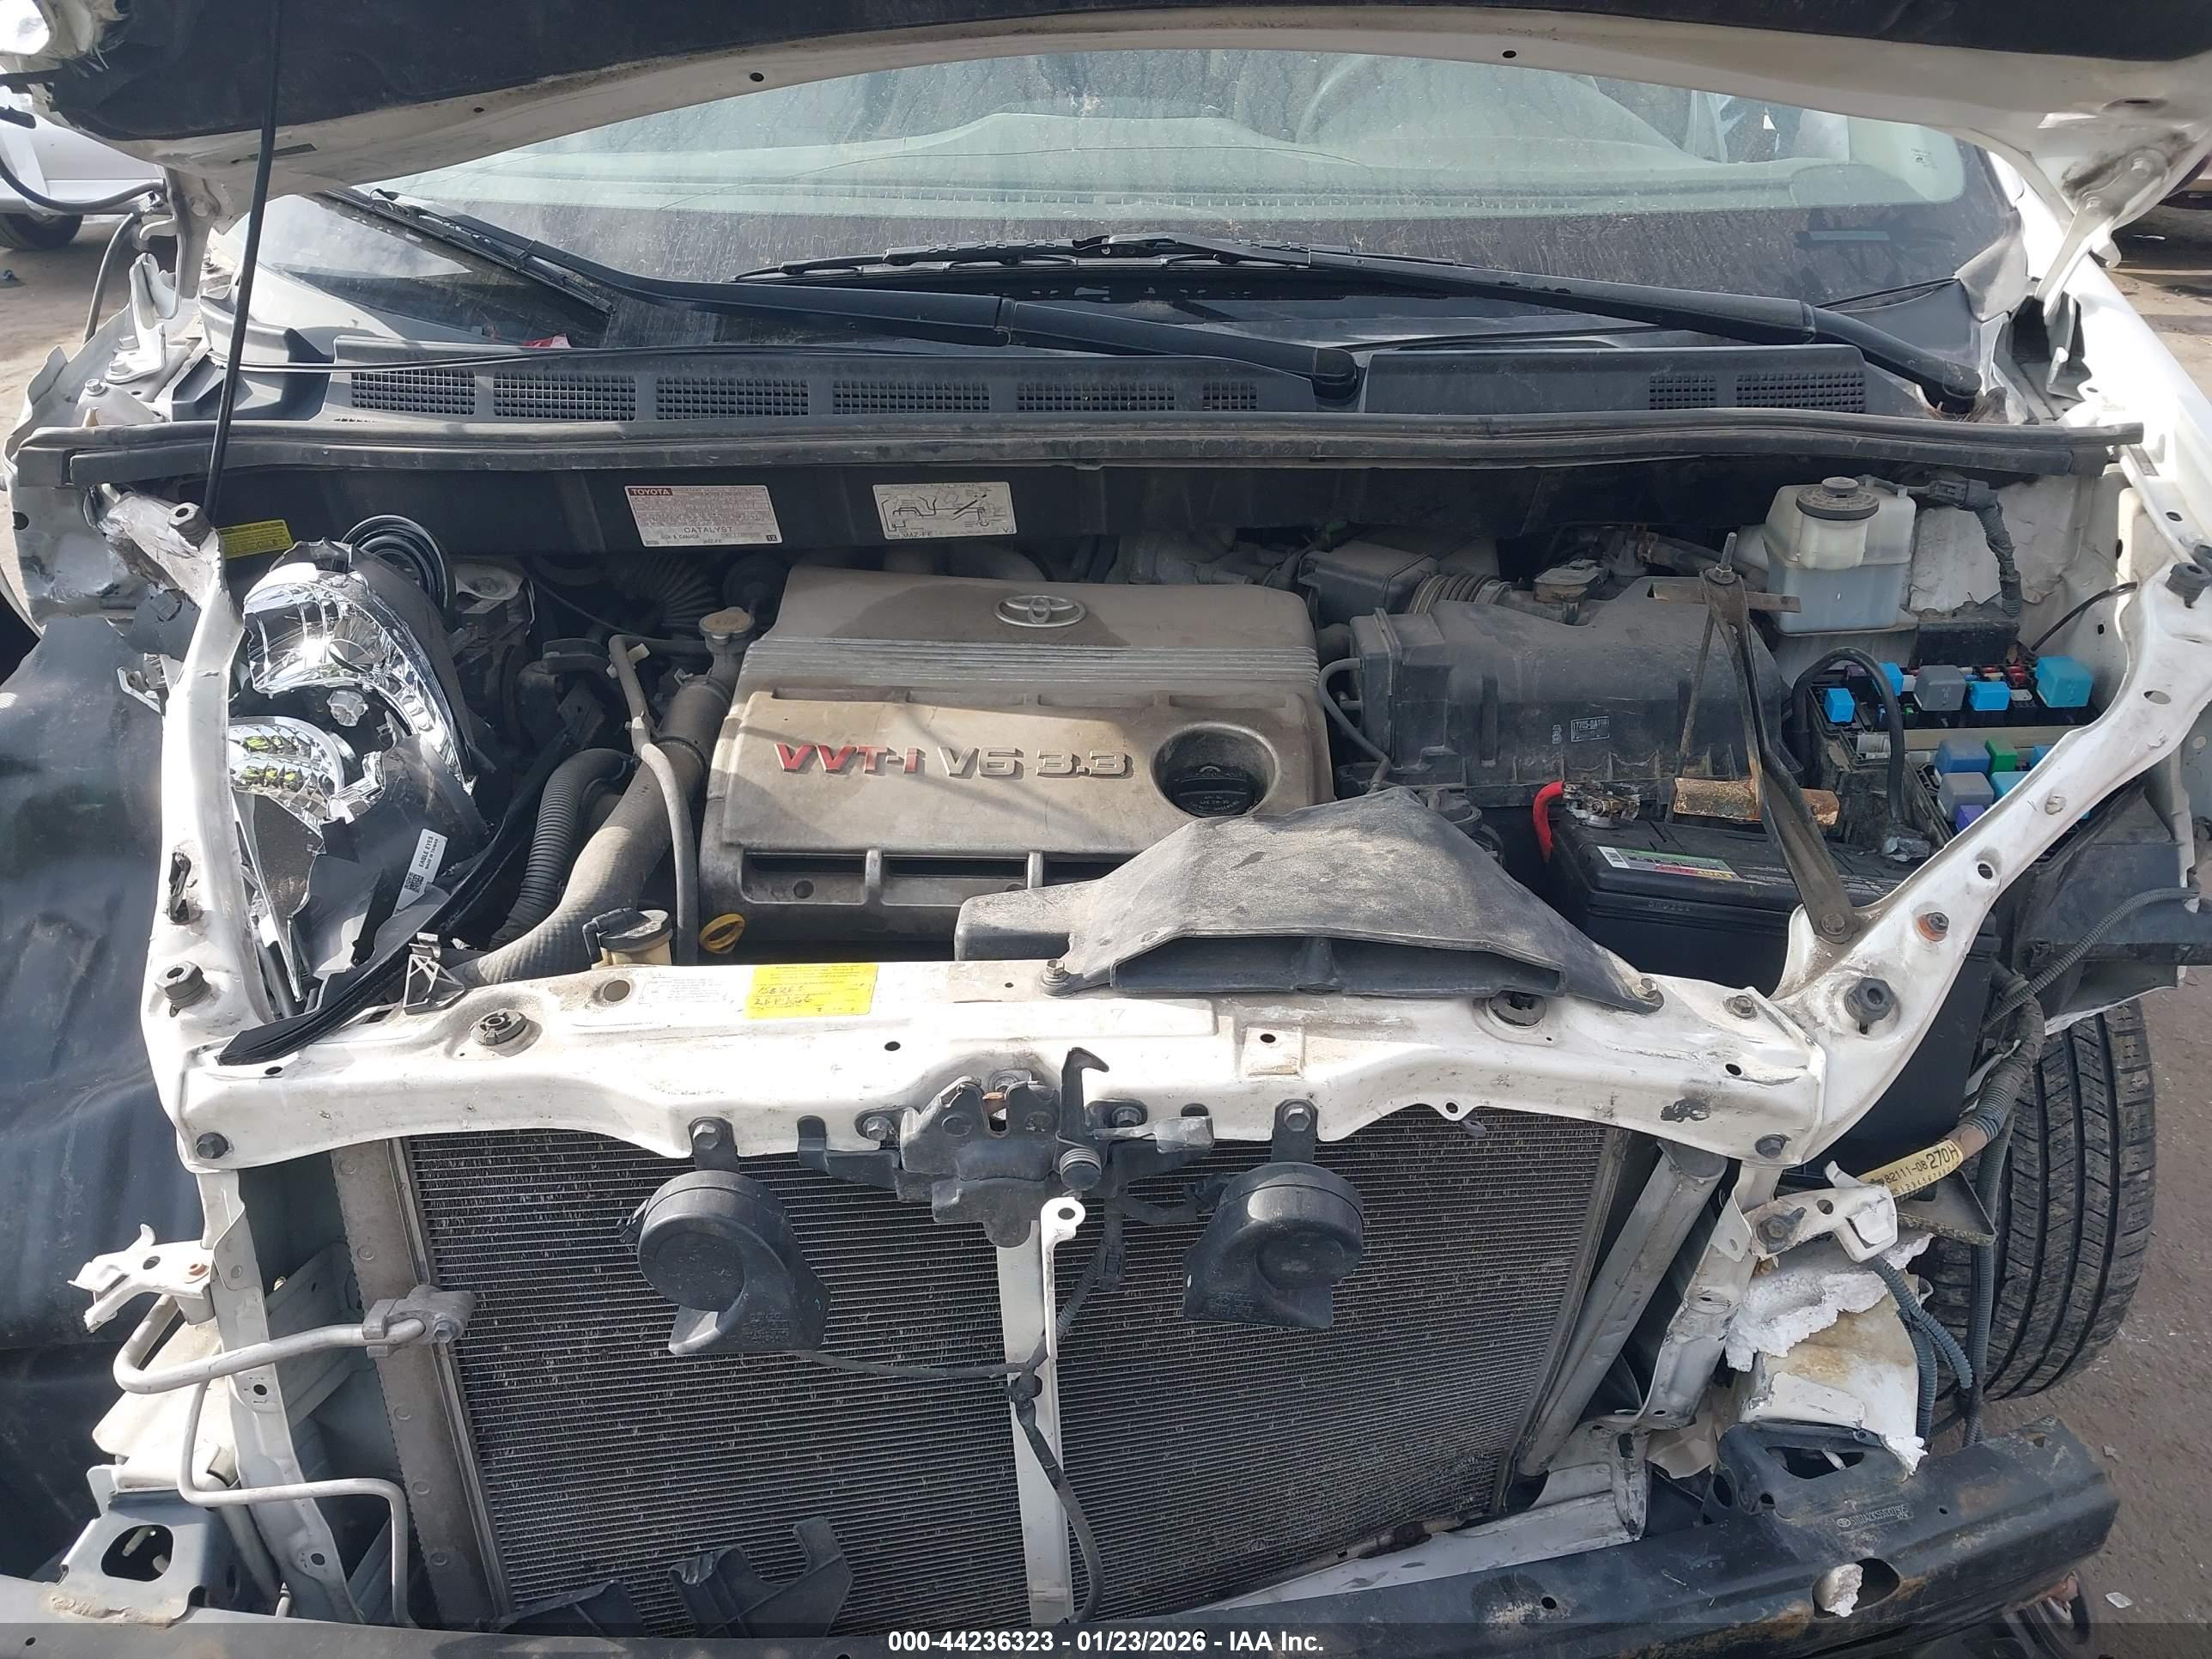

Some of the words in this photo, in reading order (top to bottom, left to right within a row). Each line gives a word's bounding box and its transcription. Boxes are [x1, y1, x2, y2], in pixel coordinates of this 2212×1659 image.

[938, 746, 1024, 777] V6
[1036, 748, 1133, 777] 3.3
[418, 850, 428, 867] EAGLE
[425, 836, 434, 850] EYES
